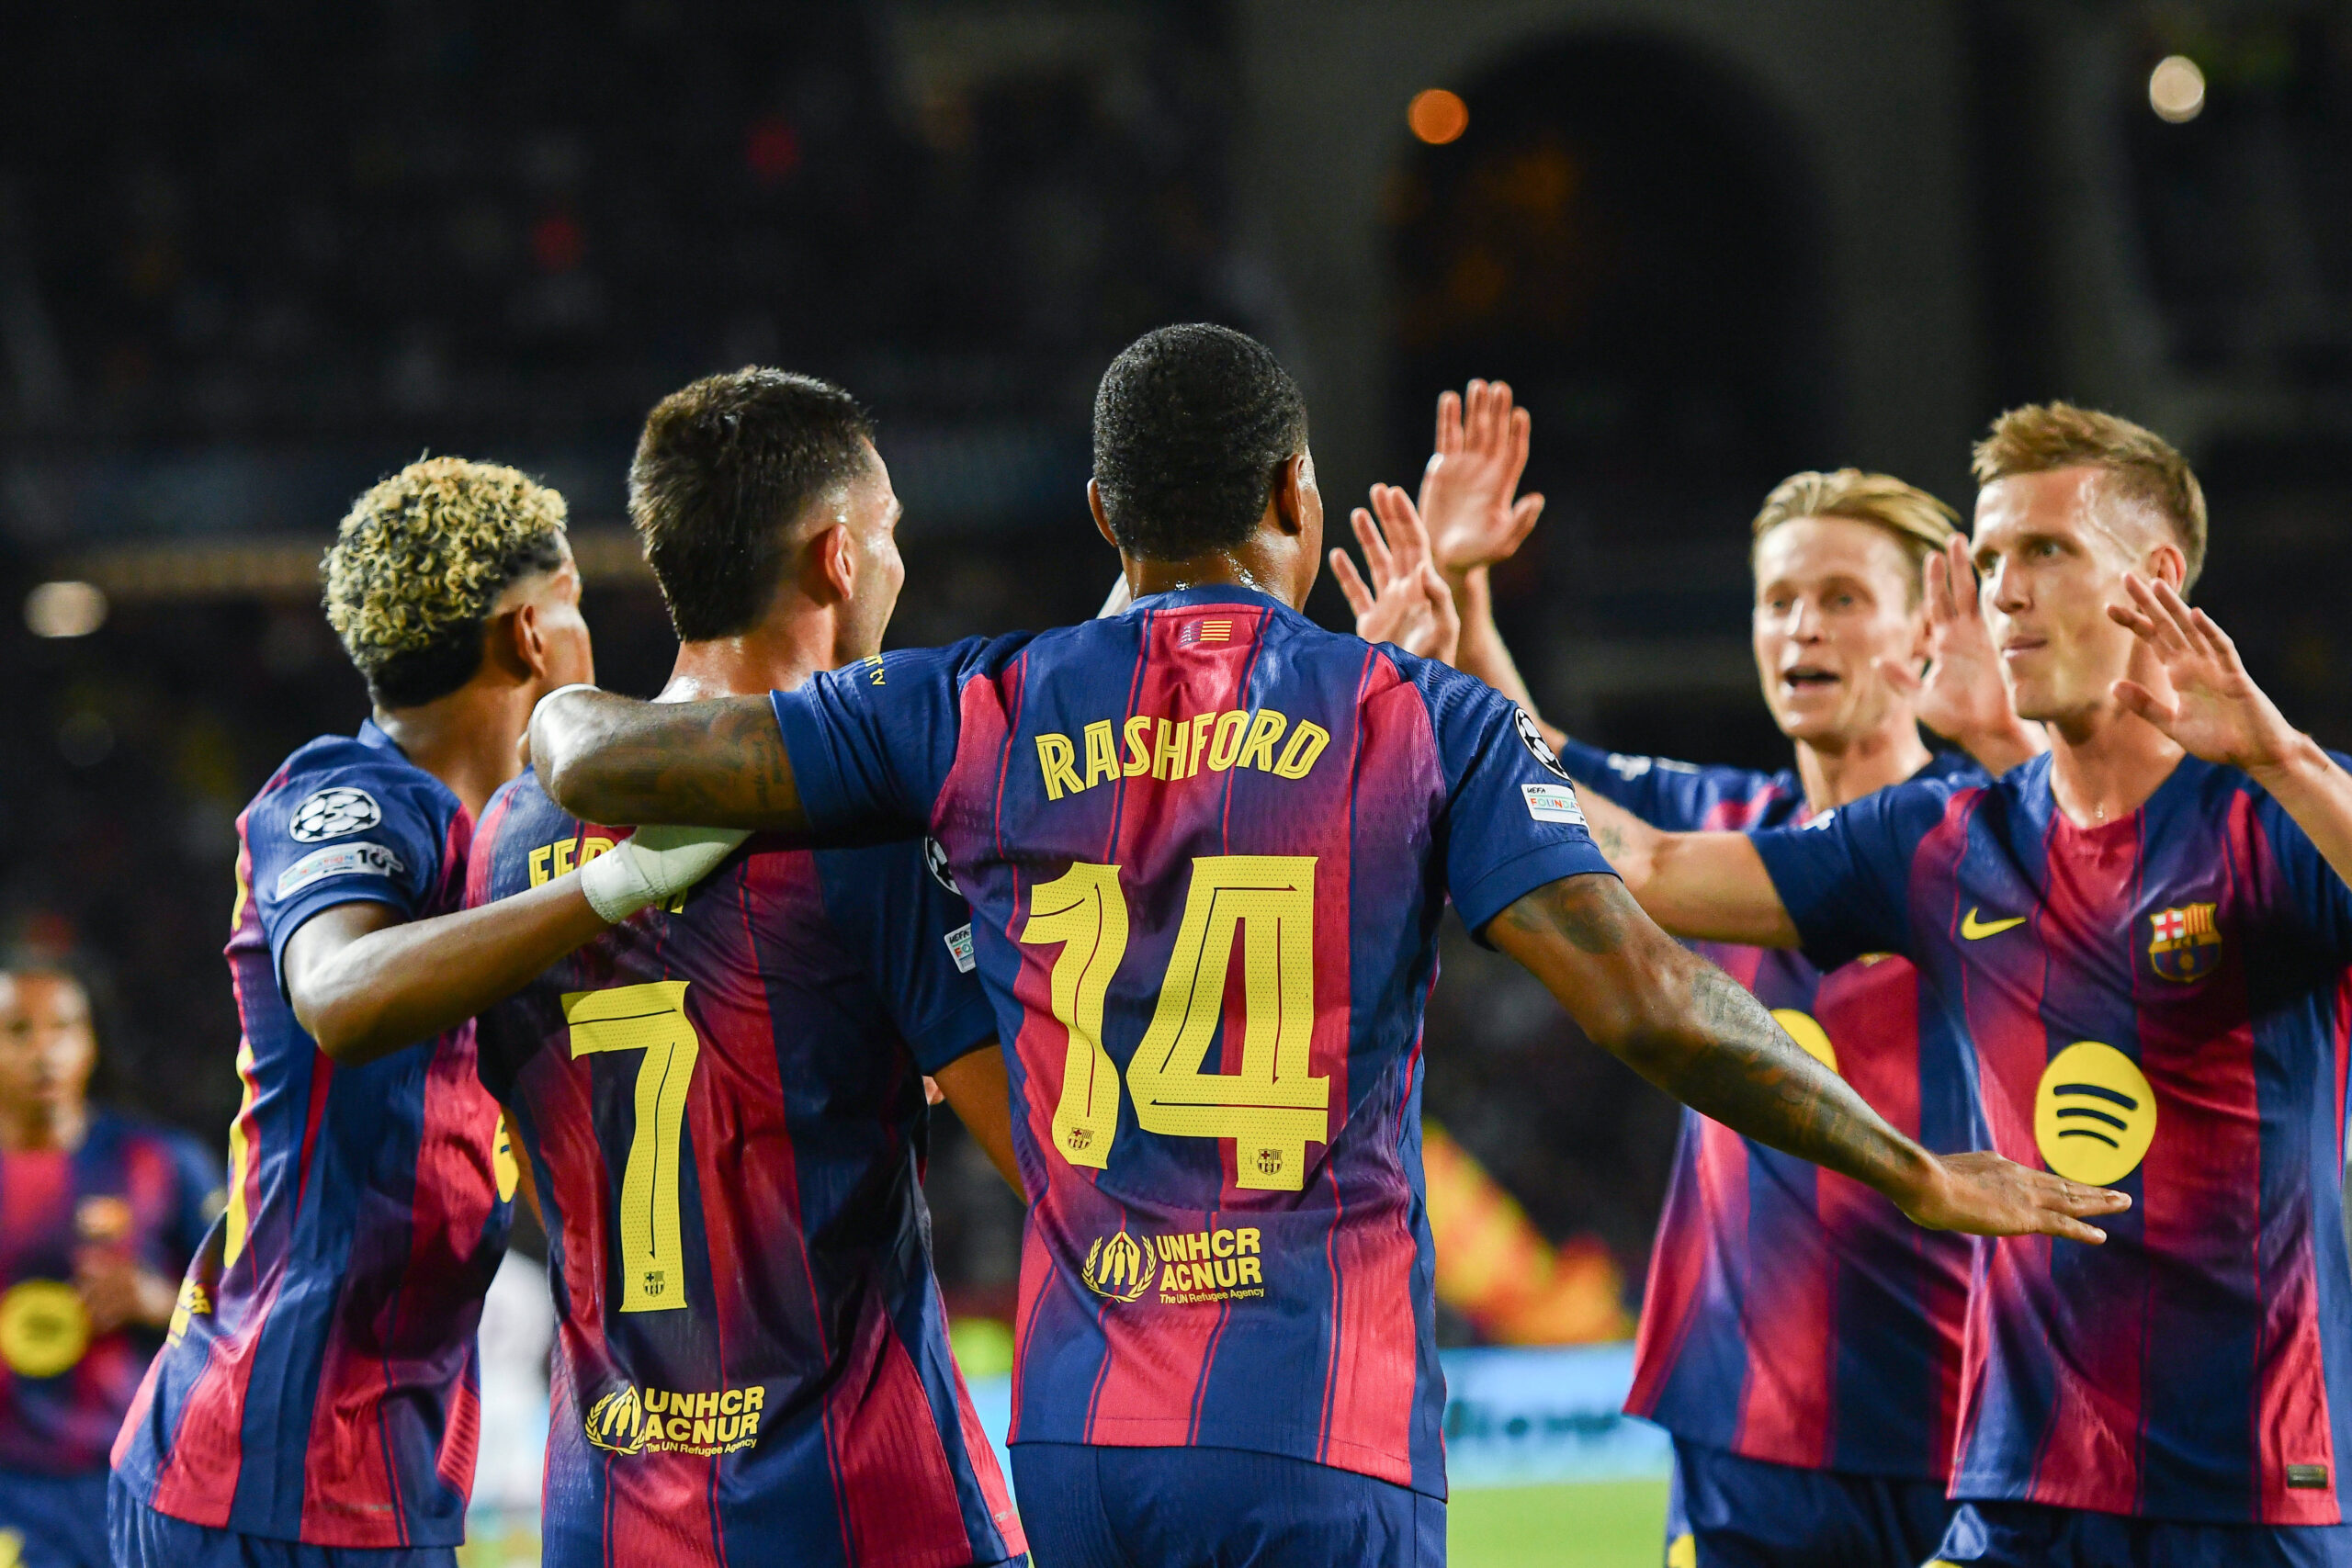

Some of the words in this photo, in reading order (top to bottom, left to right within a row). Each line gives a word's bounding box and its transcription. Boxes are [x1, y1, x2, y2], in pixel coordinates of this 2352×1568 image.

[1035, 708, 1330, 801] RASHFORD
[1527, 786, 1546, 795] UEFA
[1020, 854, 1329, 1191] 14
[561, 980, 700, 1313] 7
[1155, 1227, 1261, 1262] UNHCR
[1159, 1256, 1263, 1292] ACNUR
[1159, 1292, 1176, 1304] The
[1176, 1293, 1189, 1304] UN
[1189, 1291, 1229, 1304] Refugee
[1230, 1287, 1265, 1302] Agency
[644, 1385, 765, 1418] UNHCR
[645, 1412, 761, 1445] ACNUR
[646, 1442, 661, 1454] The
[662, 1441, 679, 1452] UN
[680, 1443, 724, 1458] Refugee
[724, 1438, 758, 1455] Agency
